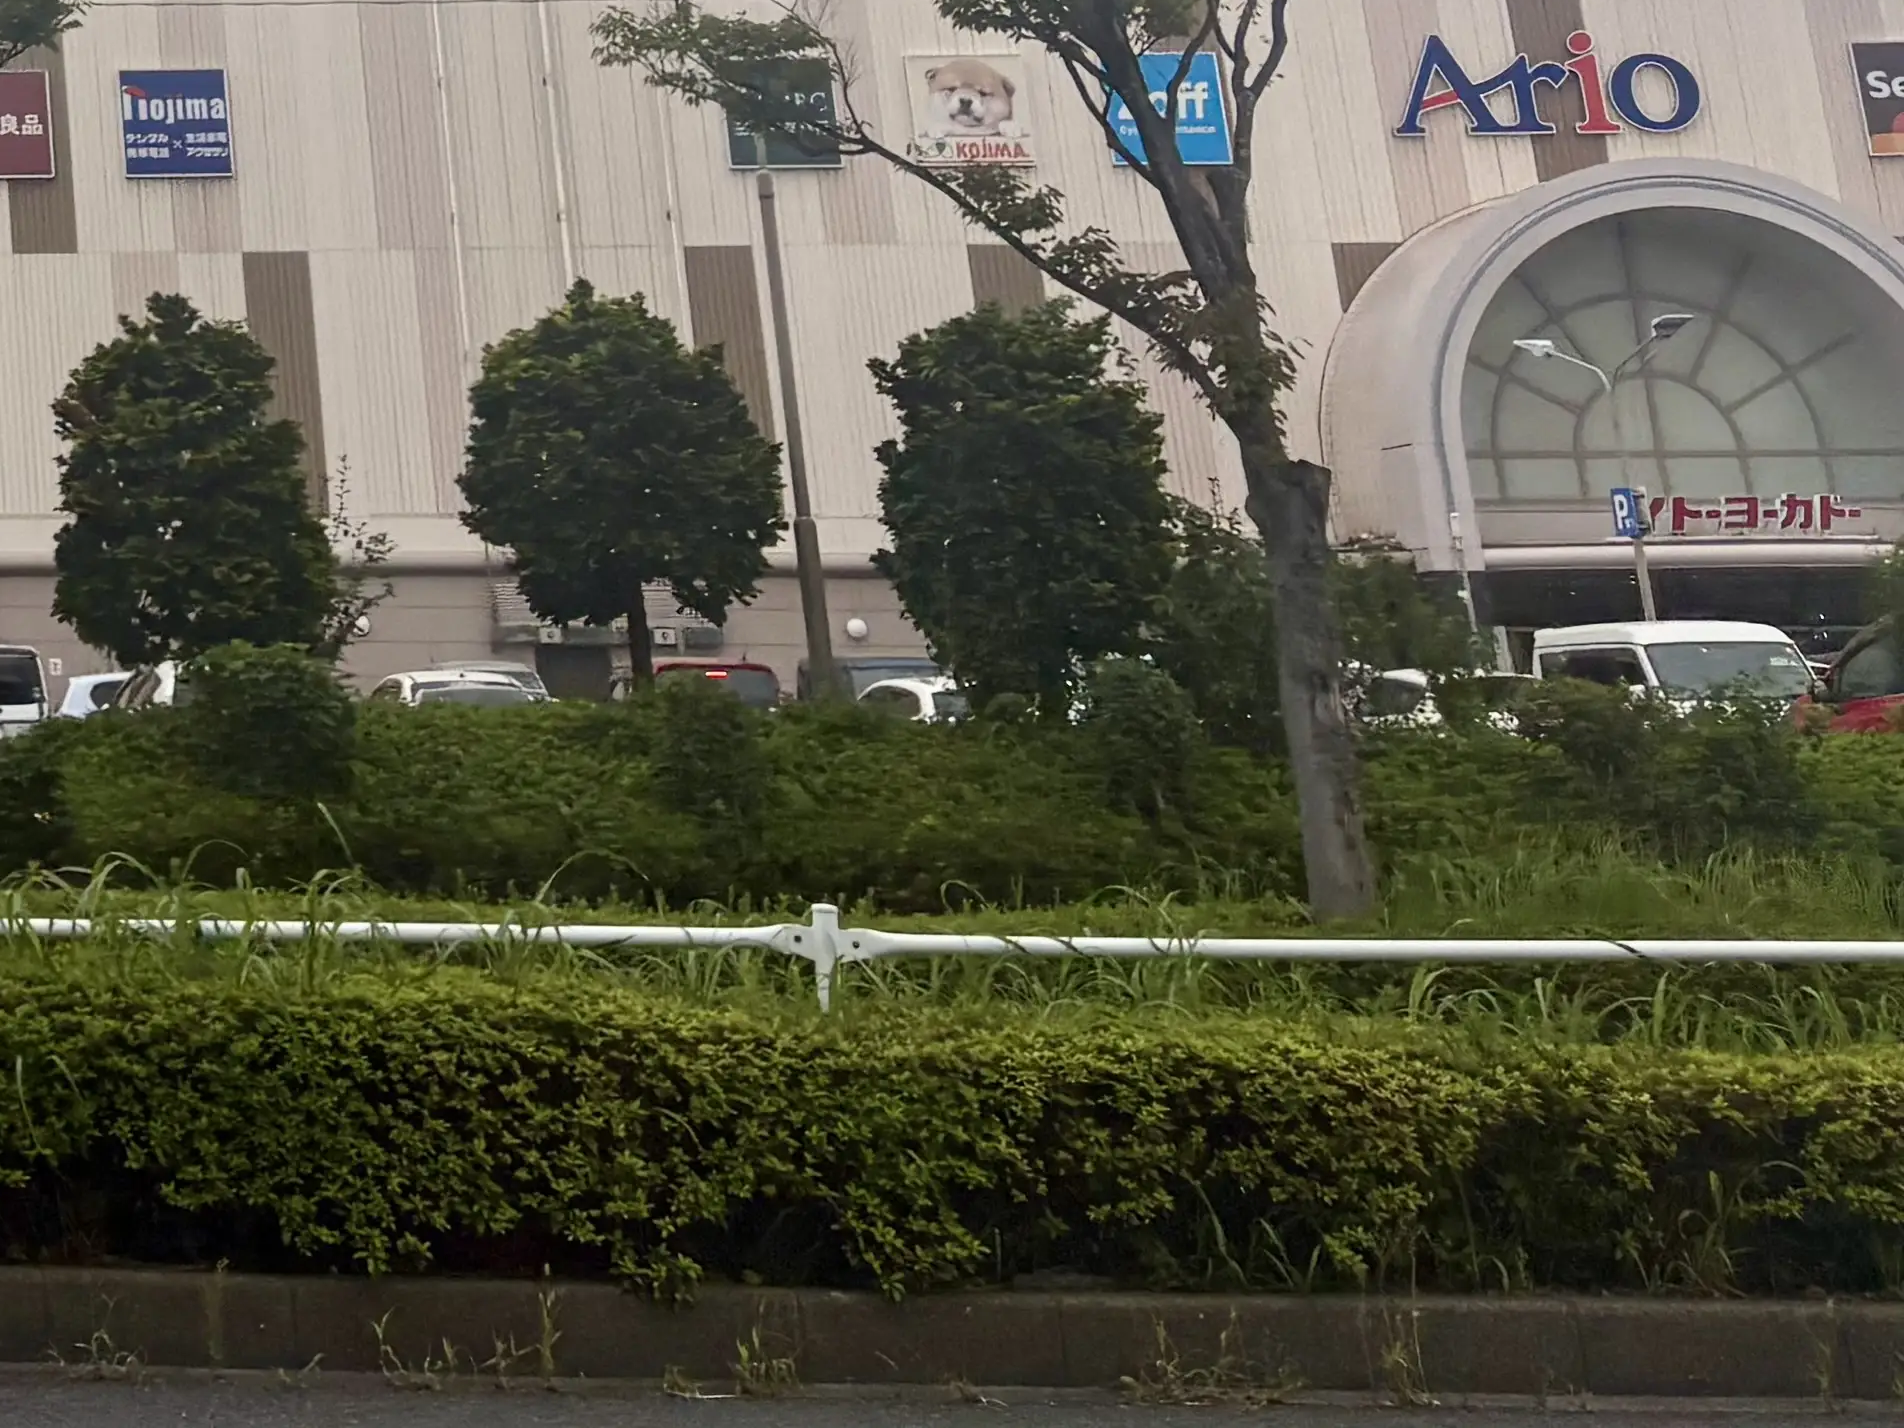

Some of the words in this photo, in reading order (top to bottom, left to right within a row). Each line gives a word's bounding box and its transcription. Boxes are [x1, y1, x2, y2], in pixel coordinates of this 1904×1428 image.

[1118, 81, 1209, 119] off
[1394, 30, 1701, 136] Ario
[956, 137, 1030, 159] KOJIMA
[1614, 495, 1629, 530] P
